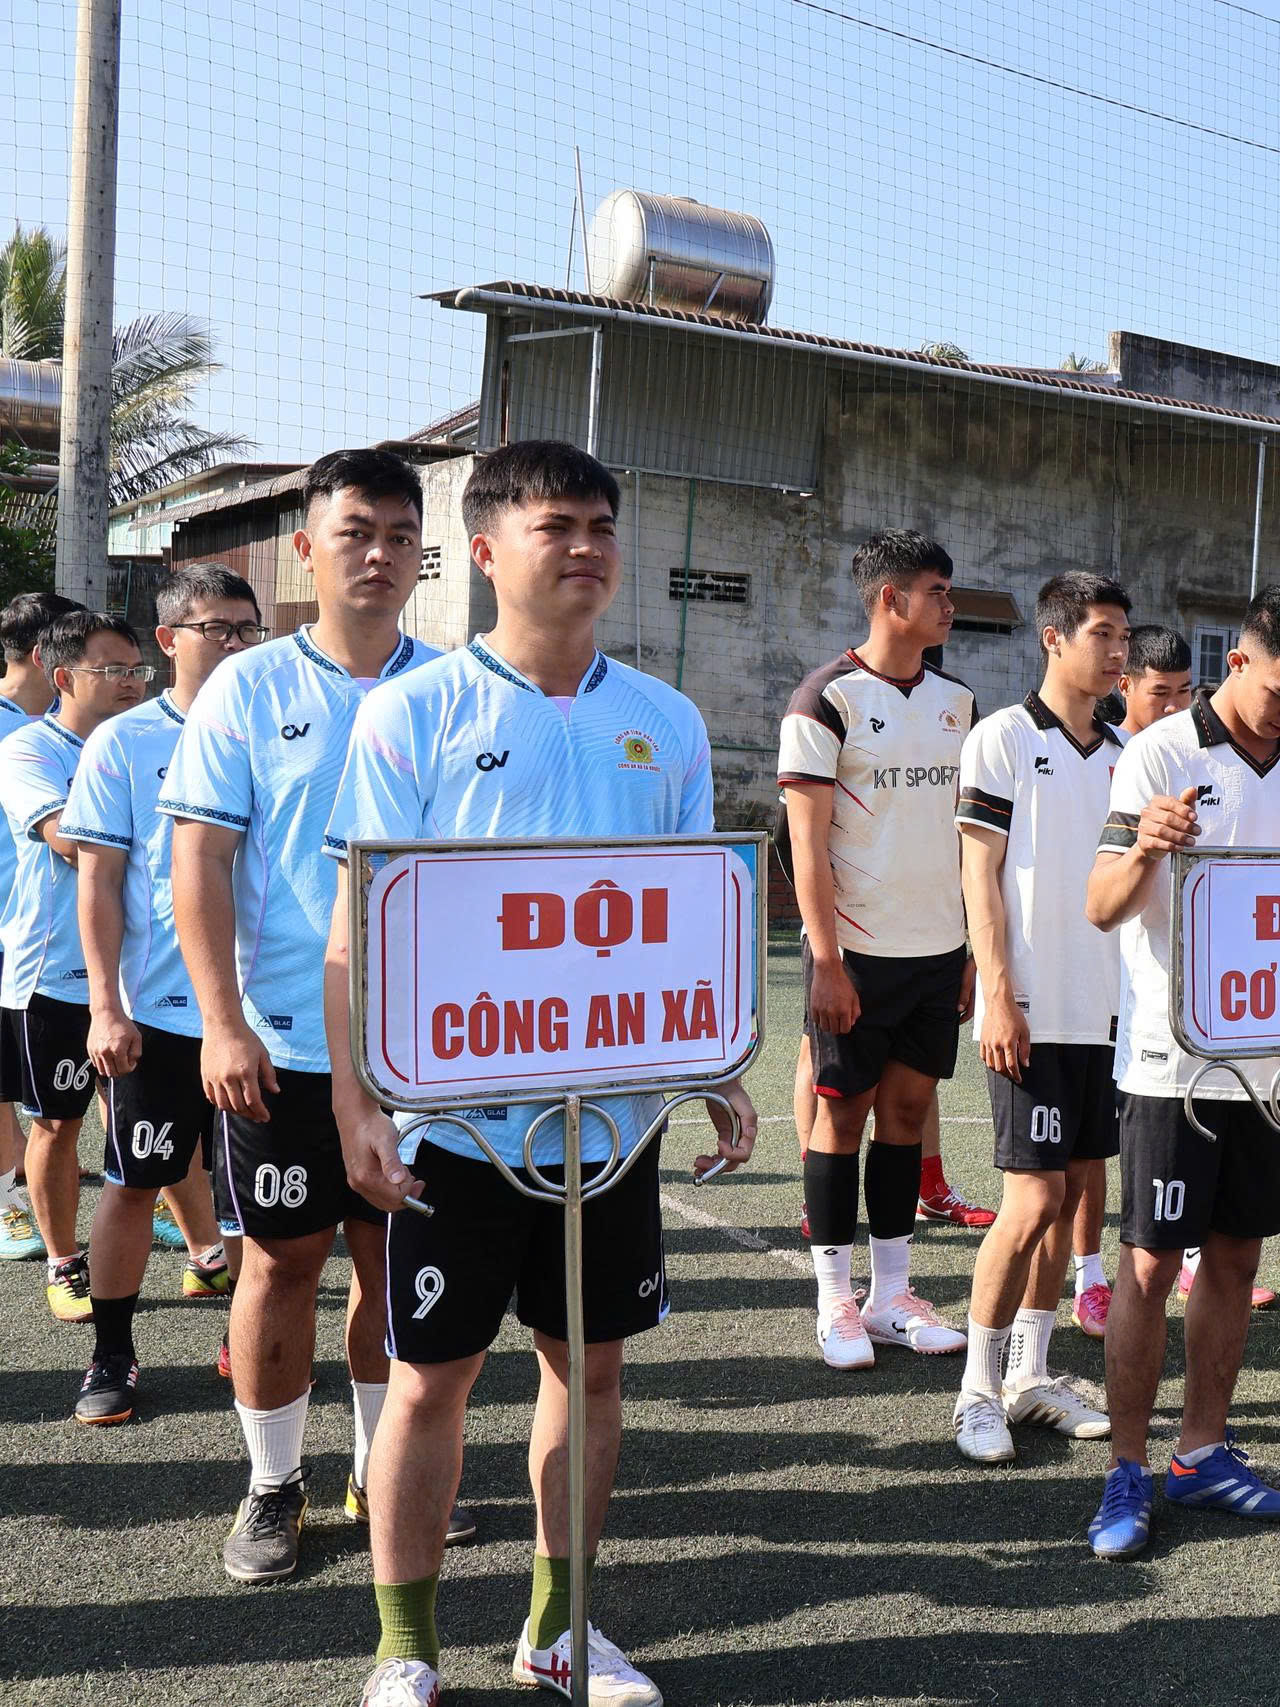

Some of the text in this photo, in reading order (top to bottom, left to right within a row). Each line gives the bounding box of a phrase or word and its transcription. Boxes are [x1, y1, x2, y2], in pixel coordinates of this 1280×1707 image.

[874, 766, 958, 789] KT SPORT
[497, 879, 668, 958] ĐỘI
[1220, 962, 1278, 1022] CƠ
[432, 979, 719, 1060] CÔNG AN XÃ
[53, 1059, 92, 1090] 06
[487, 1108, 506, 1117] GLAC
[1030, 1105, 1062, 1144] 06
[131, 1120, 174, 1160] 04
[254, 1163, 308, 1208] 08
[1152, 1178, 1186, 1221] 10
[412, 1265, 445, 1319] 9
